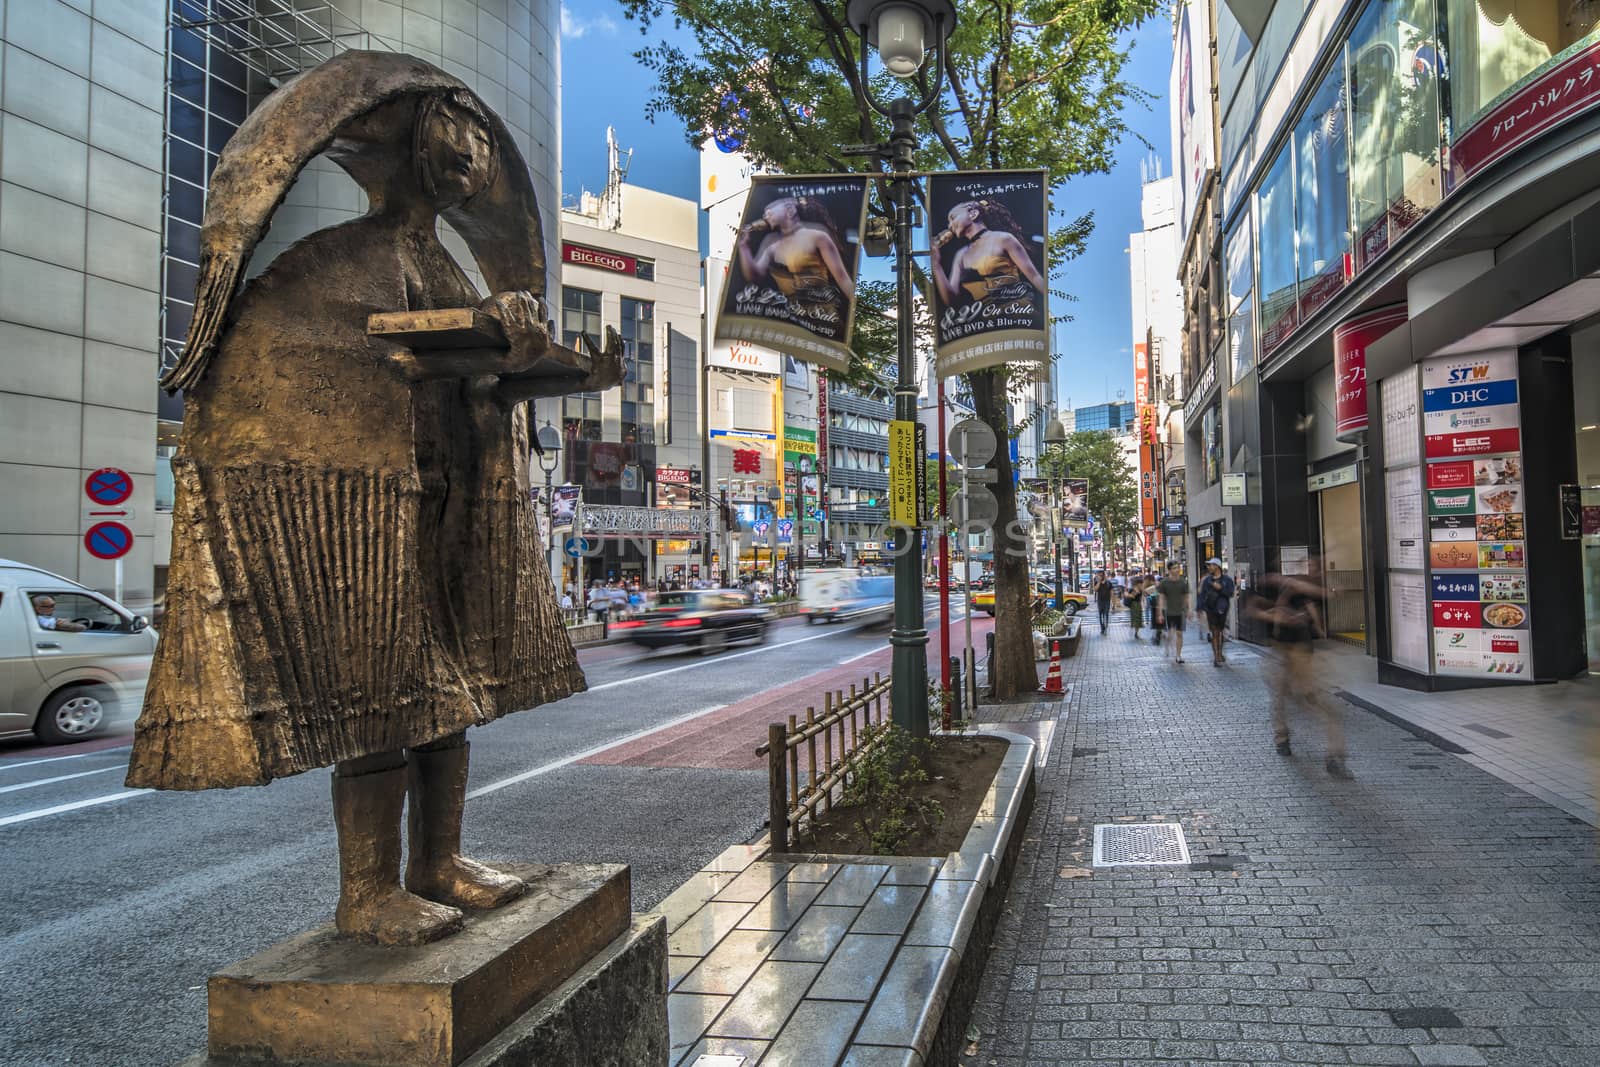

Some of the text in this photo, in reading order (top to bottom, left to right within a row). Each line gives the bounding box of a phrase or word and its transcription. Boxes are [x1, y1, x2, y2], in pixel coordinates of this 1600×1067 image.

[1492, 62, 1600, 141] グローバルクラ
[570, 250, 593, 262] BIG
[595, 255, 626, 271] ECHO
[808, 305, 840, 323] Sale
[983, 303, 1001, 317] On
[1004, 302, 1034, 315] Sale
[942, 317, 1033, 342] LIVE DVD & Blu-ray
[1448, 365, 1489, 382] STW
[1451, 388, 1489, 404] DHC
[1453, 436, 1491, 448] LEC
